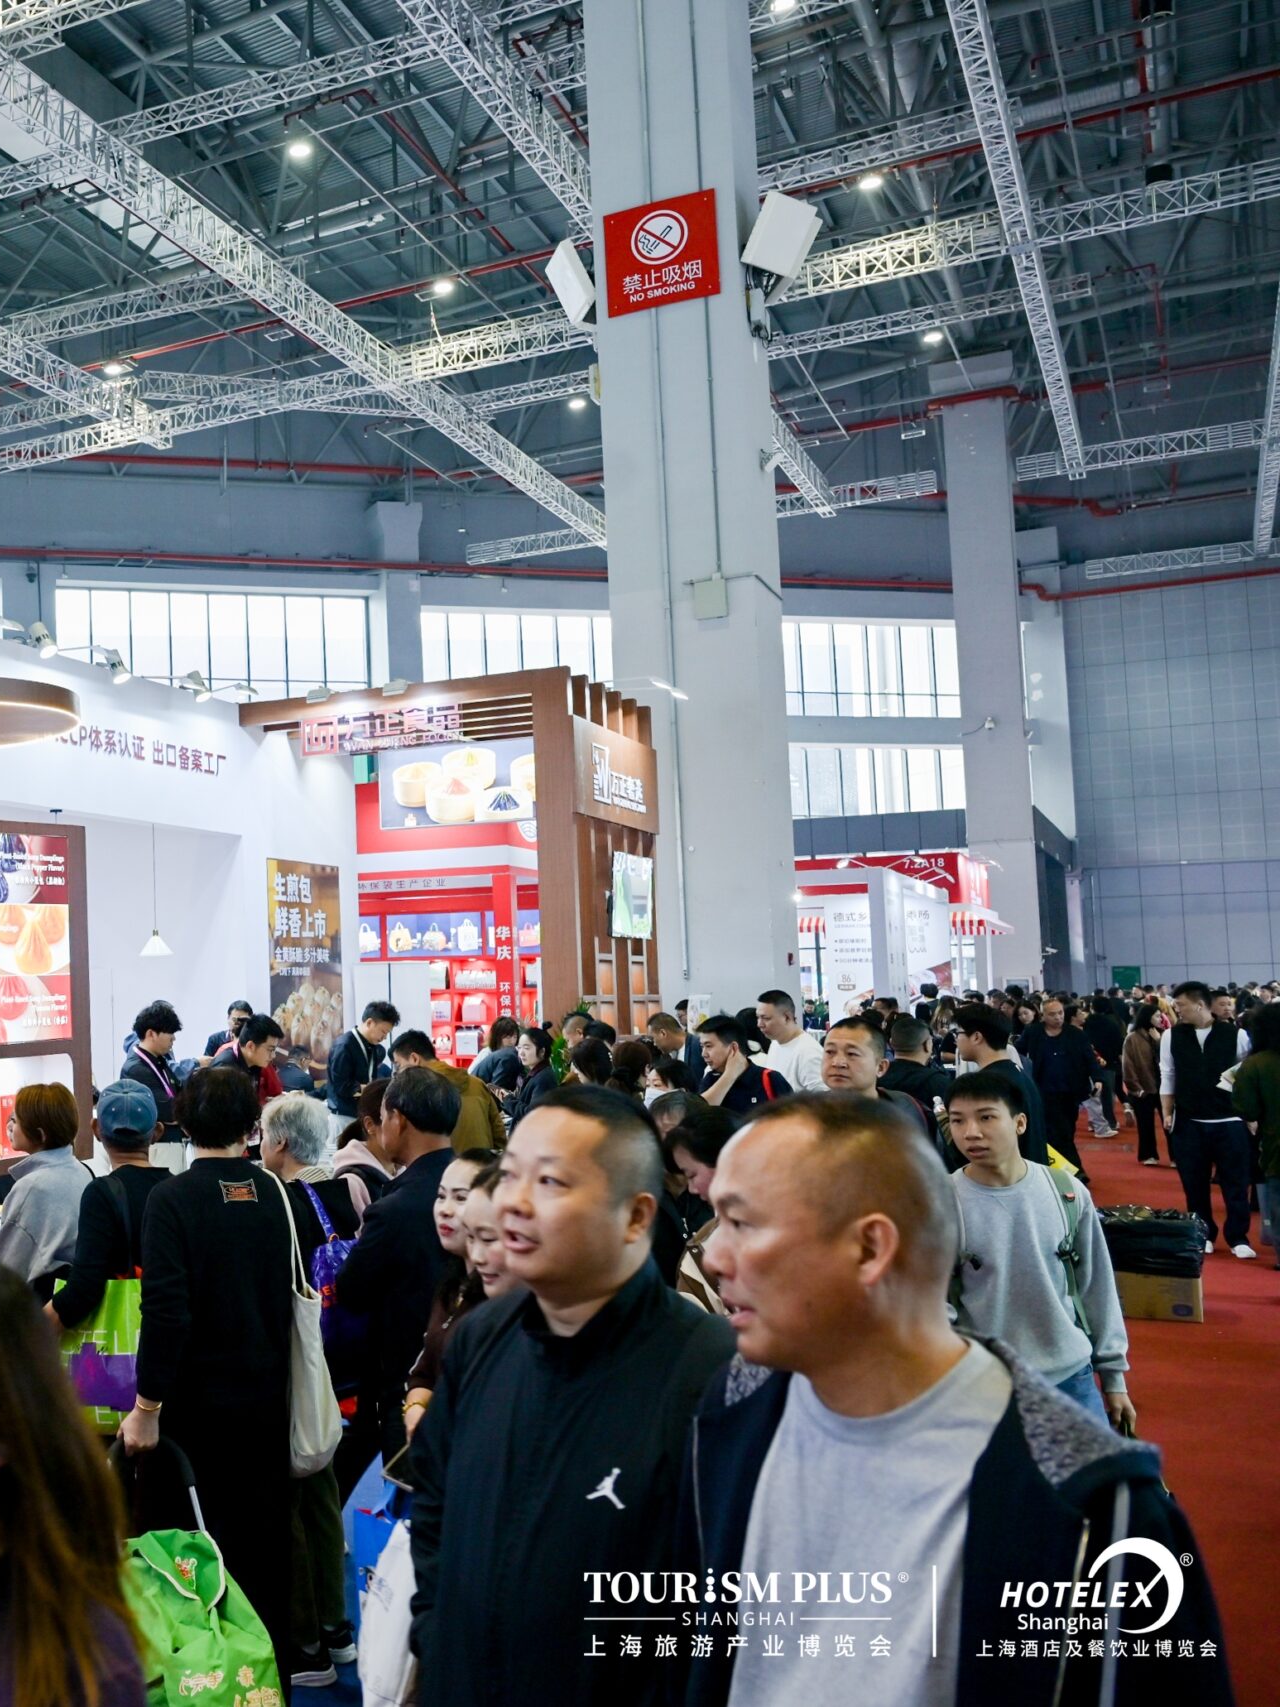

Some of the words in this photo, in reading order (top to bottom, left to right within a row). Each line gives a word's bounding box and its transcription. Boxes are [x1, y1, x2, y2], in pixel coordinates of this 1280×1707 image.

[622, 259, 702, 295] 禁止吸烟
[629, 292, 645, 304] NO
[647, 280, 696, 299] SMOKING
[152, 740, 227, 777] 出口备案工厂
[274, 872, 312, 904] 生煎包
[274, 906, 326, 939] 鲜香上市
[495, 926, 512, 961] 华庆
